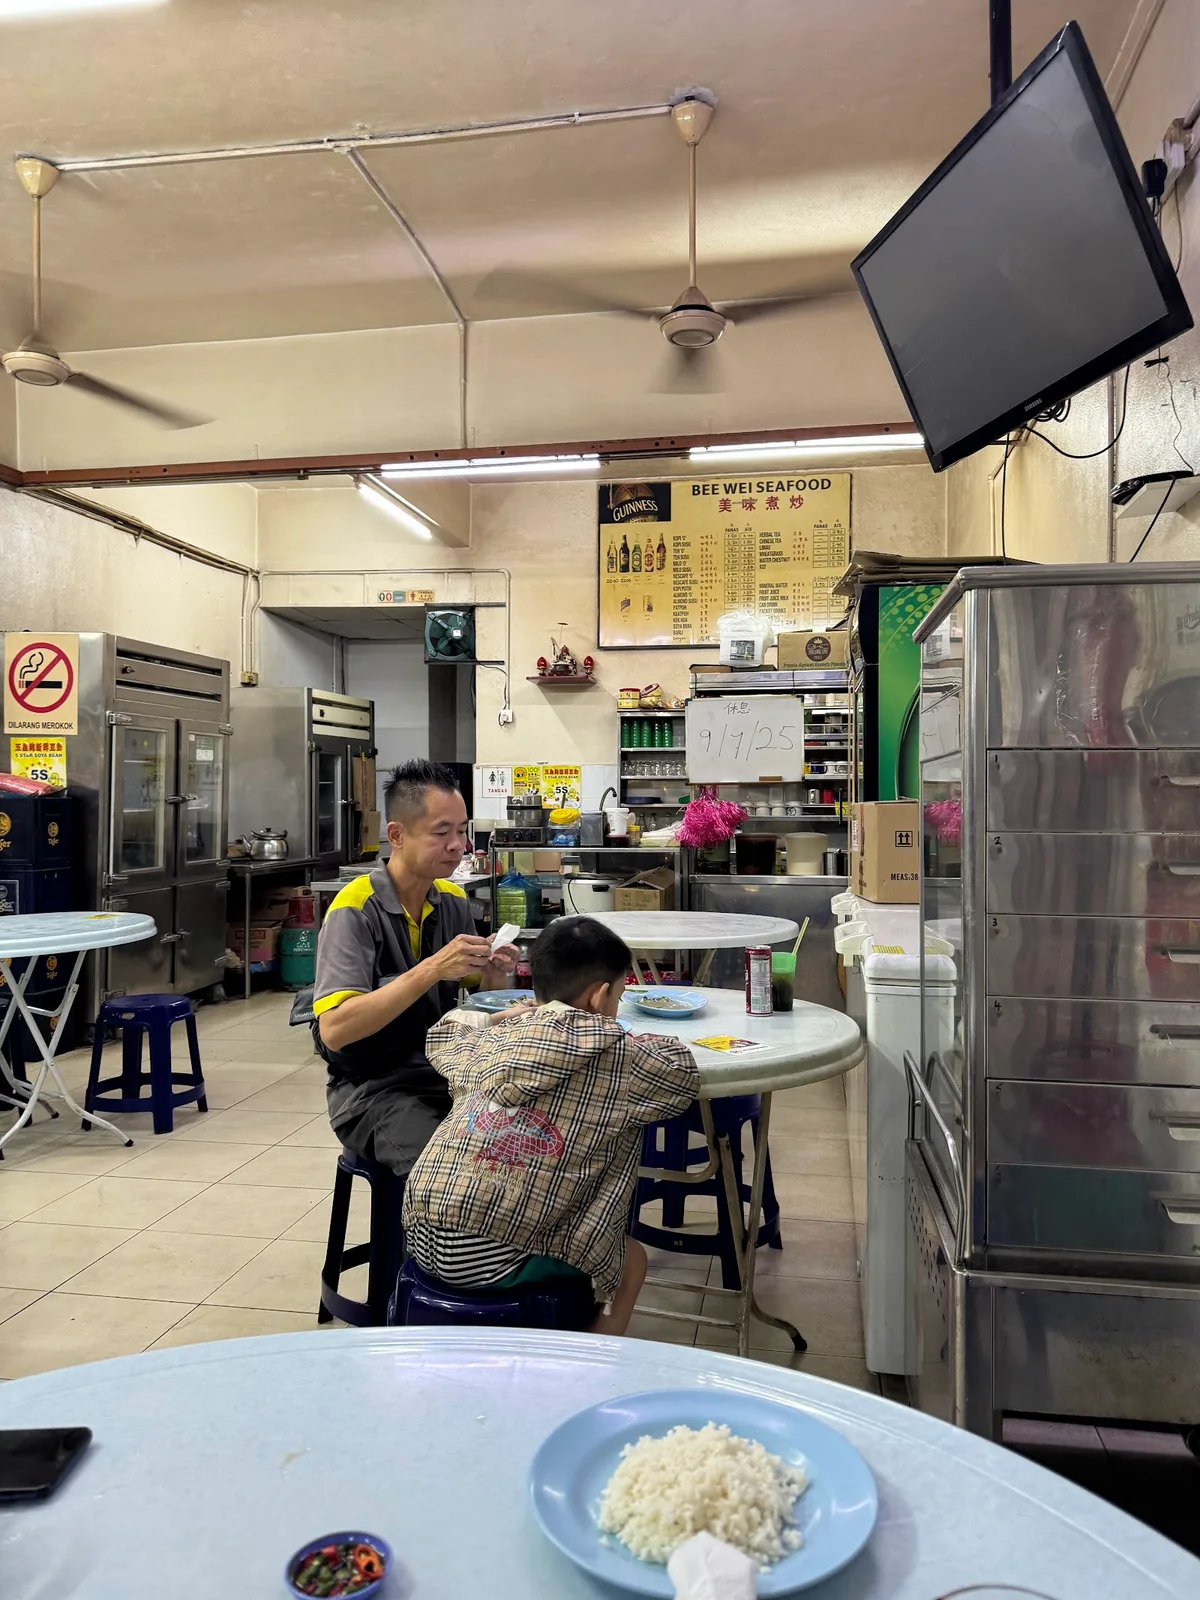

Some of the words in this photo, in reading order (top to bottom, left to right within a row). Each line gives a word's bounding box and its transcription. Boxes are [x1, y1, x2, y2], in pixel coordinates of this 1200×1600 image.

[692, 484, 720, 496] BEE
[723, 482, 752, 494] WEI
[756, 478, 832, 493] SEAFOOD
[718, 494, 804, 512] 美味煮炒
[612, 500, 658, 522] GUINNESS
[723, 702, 751, 715] 休息
[8, 721, 40, 729] DILARANG
[42, 722, 73, 730] MEROKOK
[31, 770, 48, 780] 5S
[994, 836, 1002, 845] 2
[992, 918, 998, 926] 3
[994, 1000, 1002, 1011] 4
